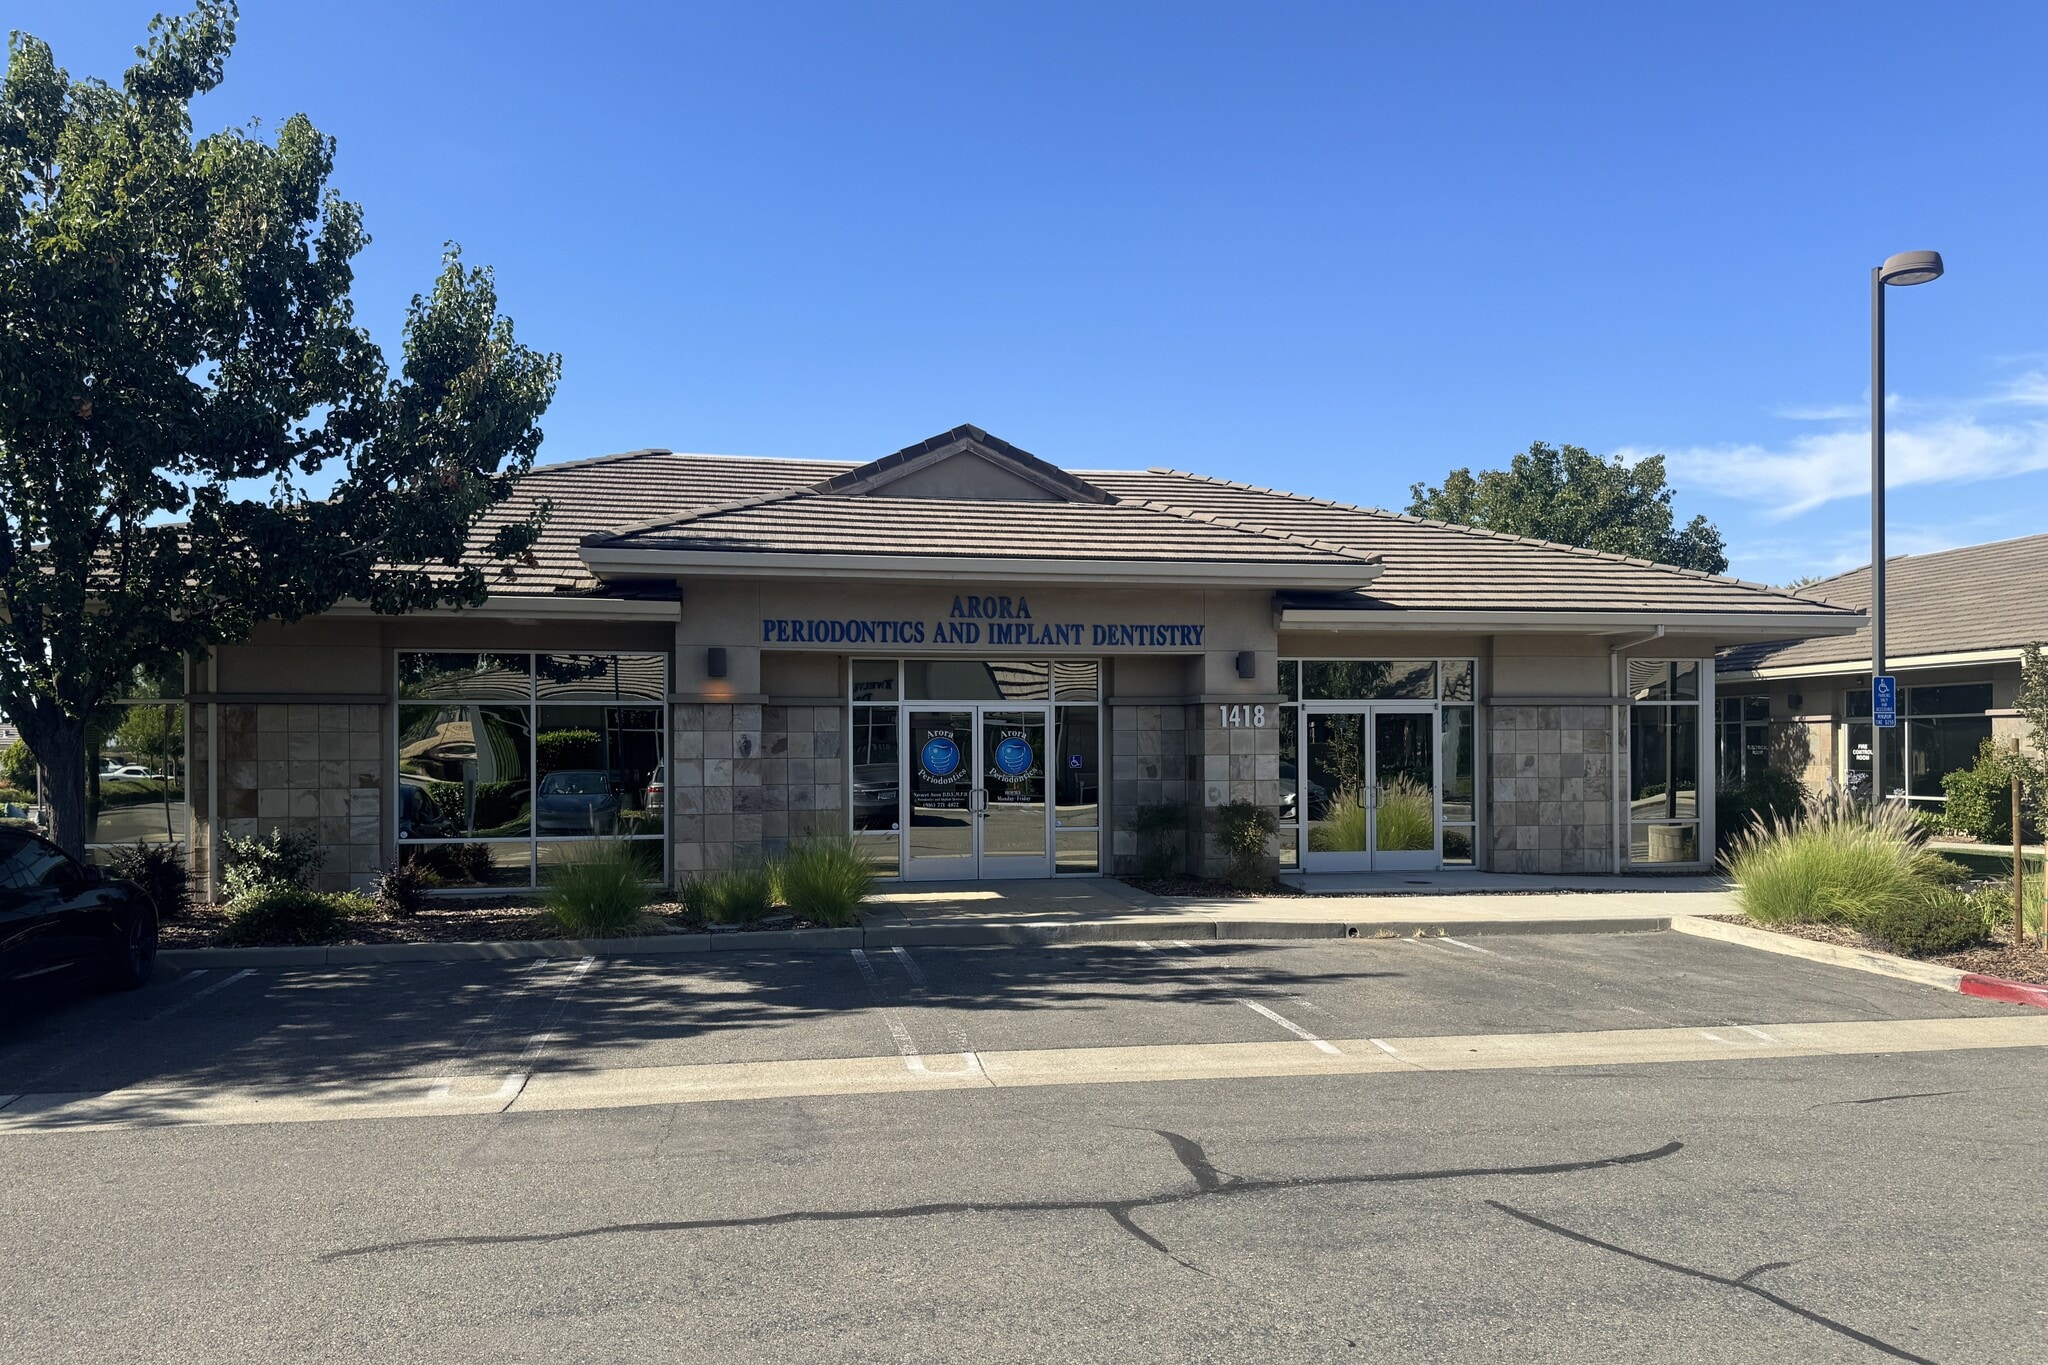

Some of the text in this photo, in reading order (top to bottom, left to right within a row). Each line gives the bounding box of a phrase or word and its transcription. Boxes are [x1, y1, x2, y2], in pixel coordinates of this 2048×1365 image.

[950, 596, 1032, 619] ARORA
[762, 619, 1205, 647] PERIODONTICS AND IMPLANT DENTISTRY
[1220, 705, 1265, 728] 1418
[927, 729, 954, 740] Arora
[1000, 730, 1028, 740] Arora
[917, 768, 967, 785] Periodontics
[988, 766, 1040, 783] Periodontics
